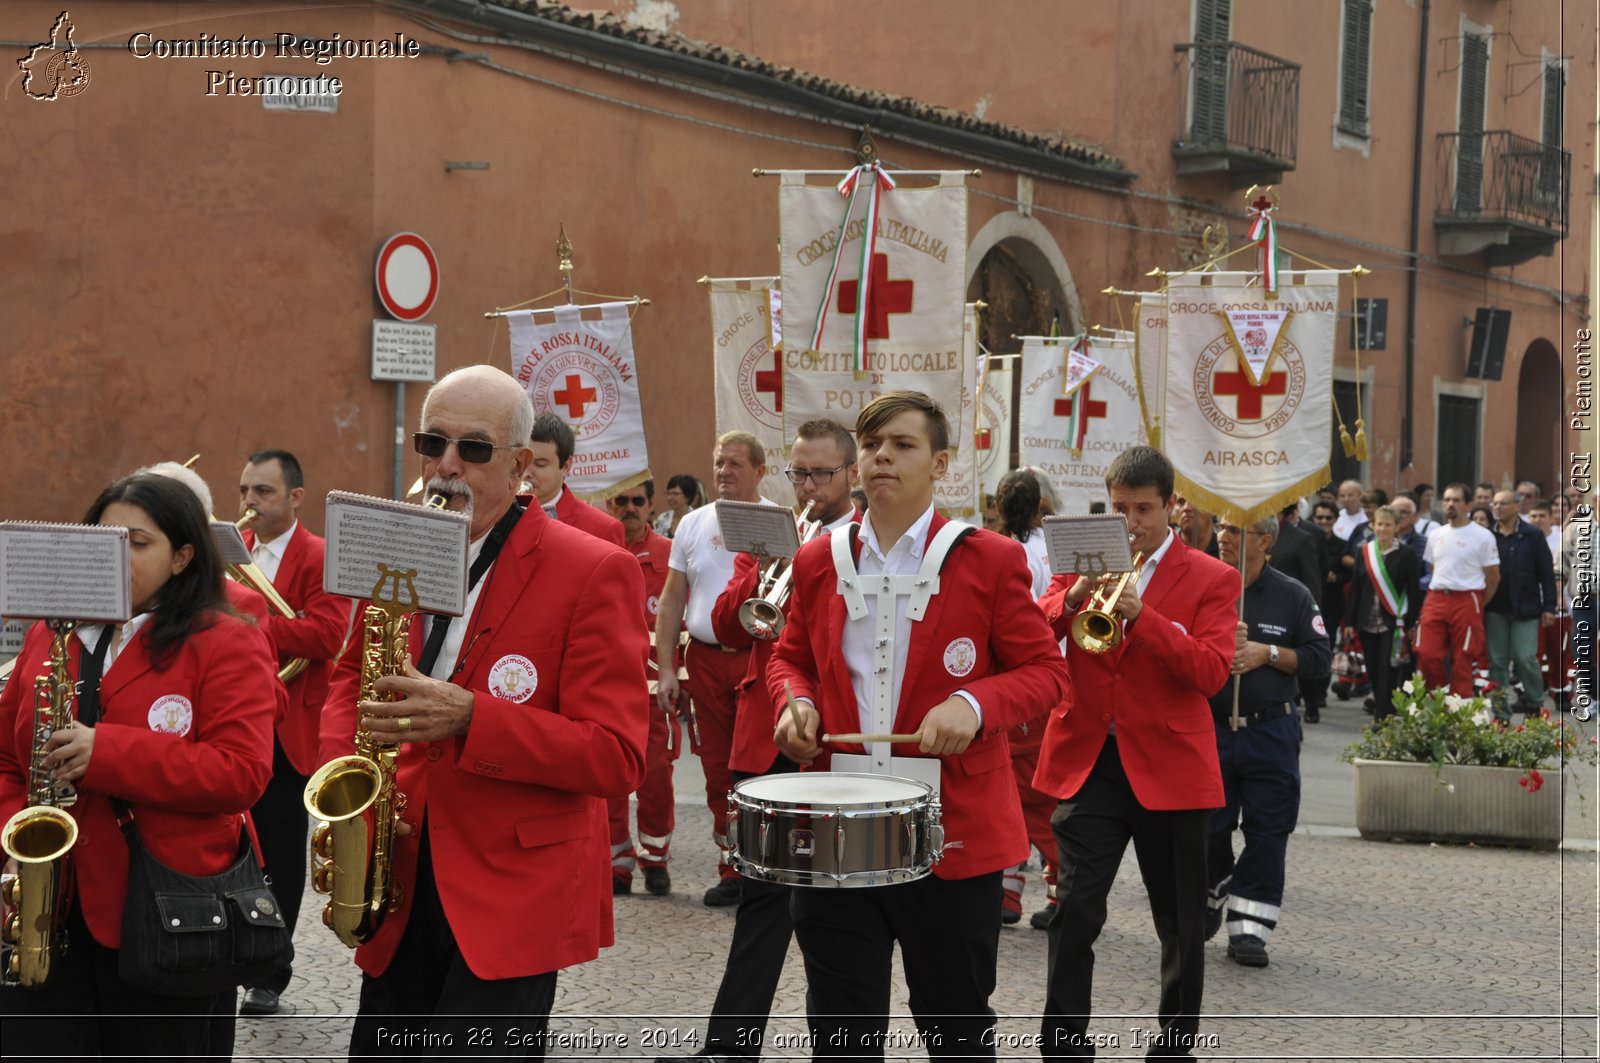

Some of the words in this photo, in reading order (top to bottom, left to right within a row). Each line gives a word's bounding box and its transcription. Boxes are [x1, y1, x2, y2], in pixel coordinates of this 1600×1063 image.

[796, 229, 837, 267] CROCE
[886, 218, 949, 264] ITALIANA
[1169, 302, 1217, 315] CROCE
[1274, 301, 1335, 314] ITALIANA
[717, 311, 754, 348] CROCE
[541, 332, 580, 354] ROSSA
[584, 334, 633, 383] ITALIANA
[1210, 342, 1223, 357] DI
[1279, 342, 1292, 357] 22
[786, 350, 887, 373] COMITTO
[889, 351, 958, 373] LOCALE
[555, 354, 596, 373] GINEVRA
[600, 382, 617, 421] AGOSTO
[739, 350, 764, 418] CONVENZIONE
[871, 373, 885, 385] DI
[1025, 368, 1055, 395] CROCE
[1098, 366, 1138, 402] TALIANA
[1287, 359, 1304, 408] AGOSTO
[1196, 354, 1236, 432] CONVENZIONE
[1264, 408, 1290, 431] 1864
[1023, 437, 1069, 449] COMITA
[590, 448, 630, 462] LOCALE
[1202, 450, 1289, 466] AIRASCA
[572, 464, 608, 477] CHIERI
[954, 472, 963, 482] DI
[493, 658, 534, 677] Filarmonica
[492, 685, 532, 701] Poirinese
